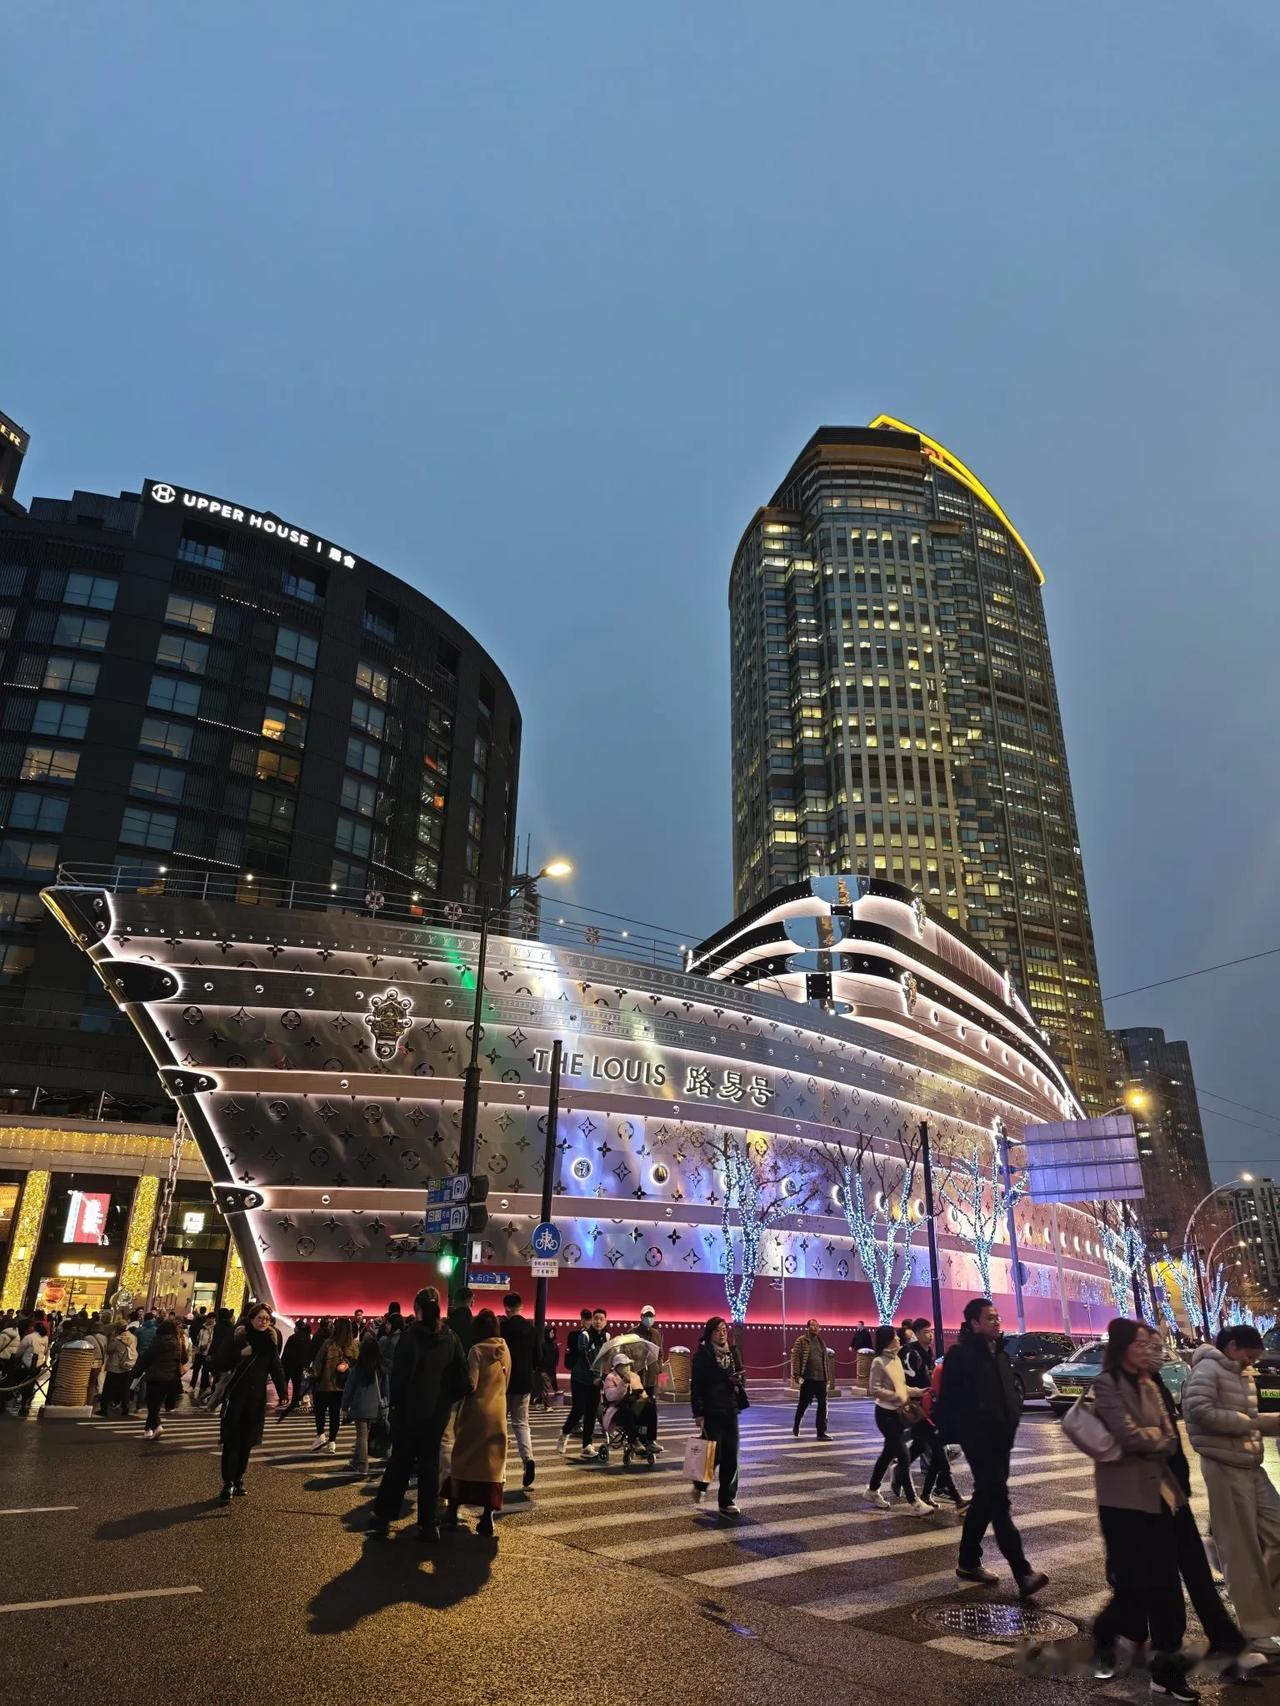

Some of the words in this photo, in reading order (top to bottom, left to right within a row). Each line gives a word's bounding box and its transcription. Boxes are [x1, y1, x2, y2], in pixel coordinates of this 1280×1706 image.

[0, 423, 20, 447] ER
[183, 493, 244, 522] UPPER
[249, 514, 308, 547] HOUSE
[534, 1048, 584, 1076] THE
[592, 1055, 666, 1086] LOUIS
[685, 1065, 774, 1107] 路易号
